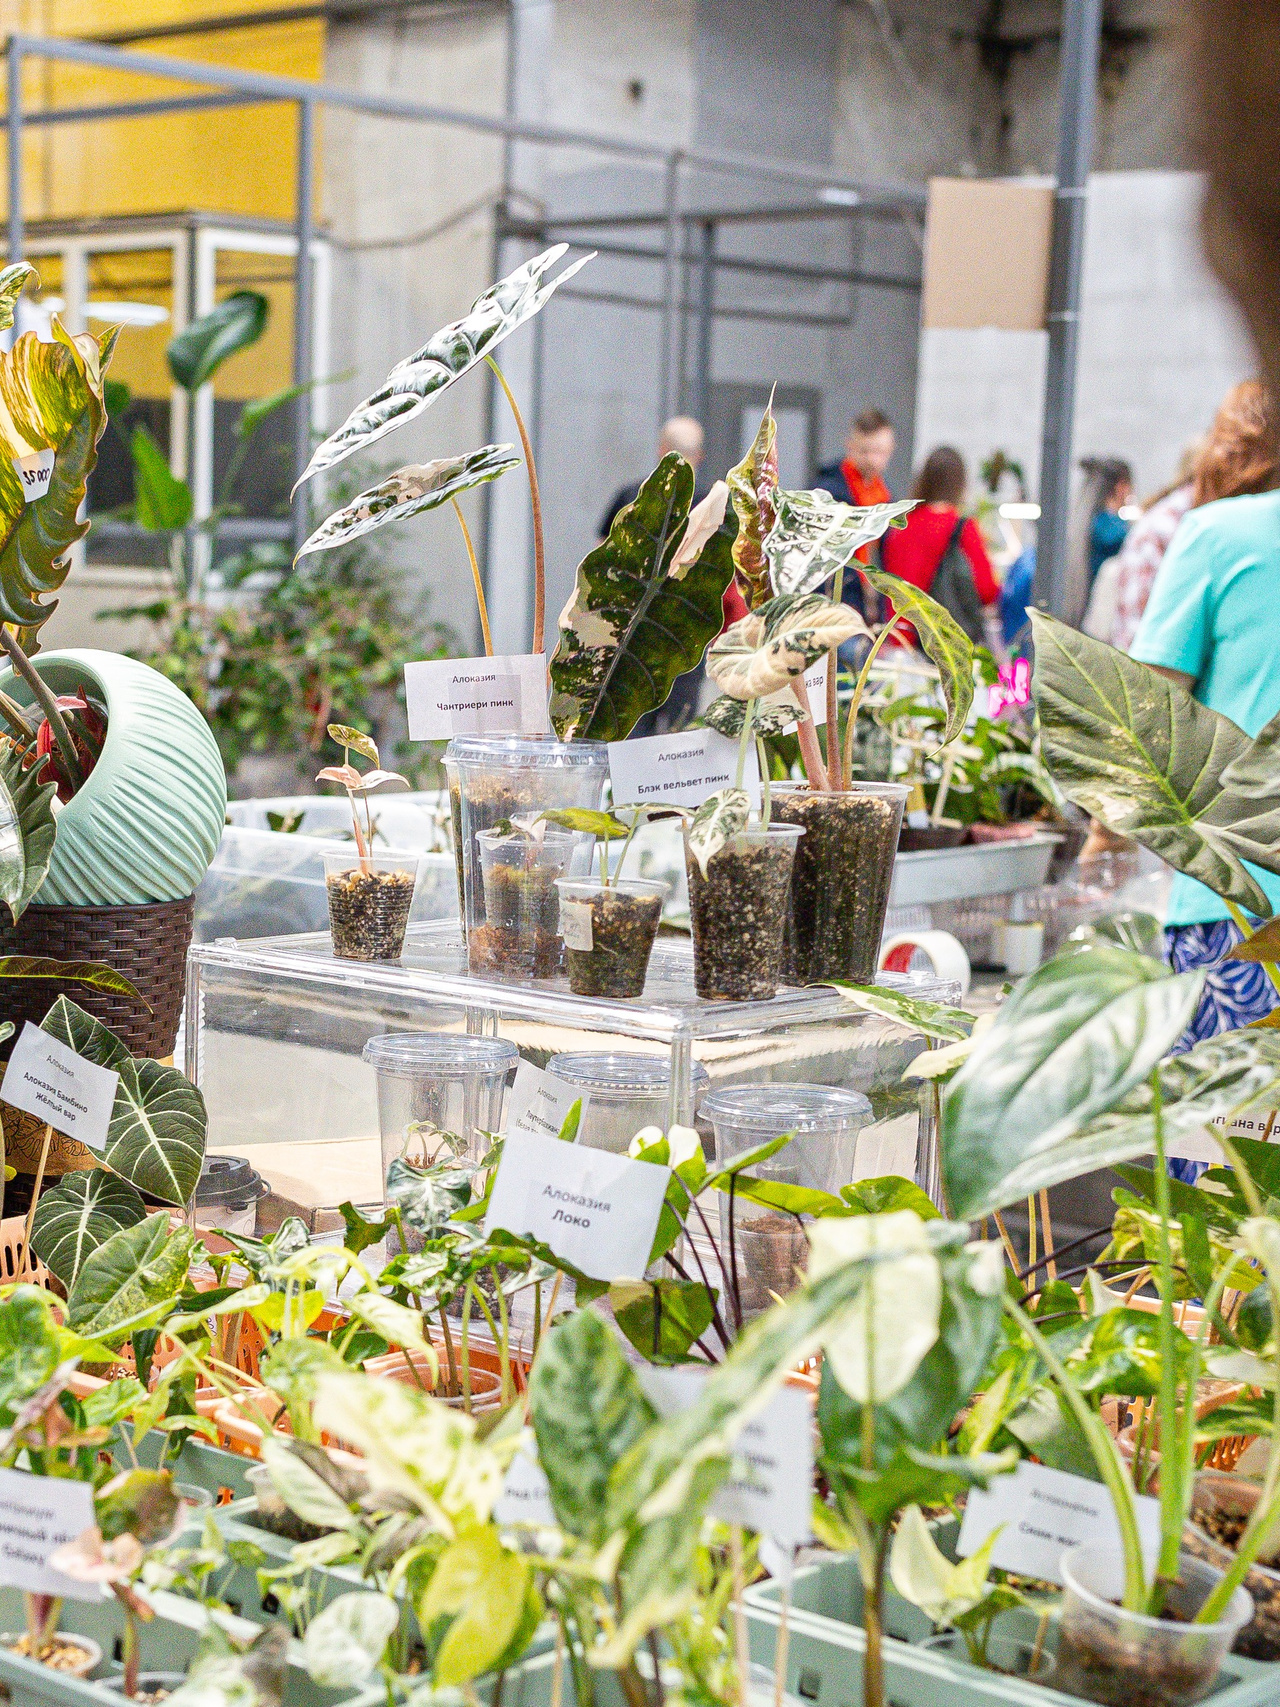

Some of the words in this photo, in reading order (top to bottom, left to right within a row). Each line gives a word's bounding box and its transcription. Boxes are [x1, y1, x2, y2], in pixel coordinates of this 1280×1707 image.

[452, 674, 496, 684] Алоказия
[436, 701, 488, 712] Чантриери
[490, 699, 514, 708] пинк
[657, 748, 705, 763] Алоказия
[637, 783, 661, 795] Блэк
[663, 777, 702, 791] вельвет
[704, 773, 730, 785] пинк
[46, 1054, 75, 1078] Алоказия
[23, 1072, 57, 1096] Алоказия
[56, 1089, 88, 1114] Бамбино
[63, 1110, 76, 1122] вар
[1257, 1122, 1280, 1136] вр
[542, 1184, 612, 1214] Алоказия
[551, 1208, 591, 1230] Локо
